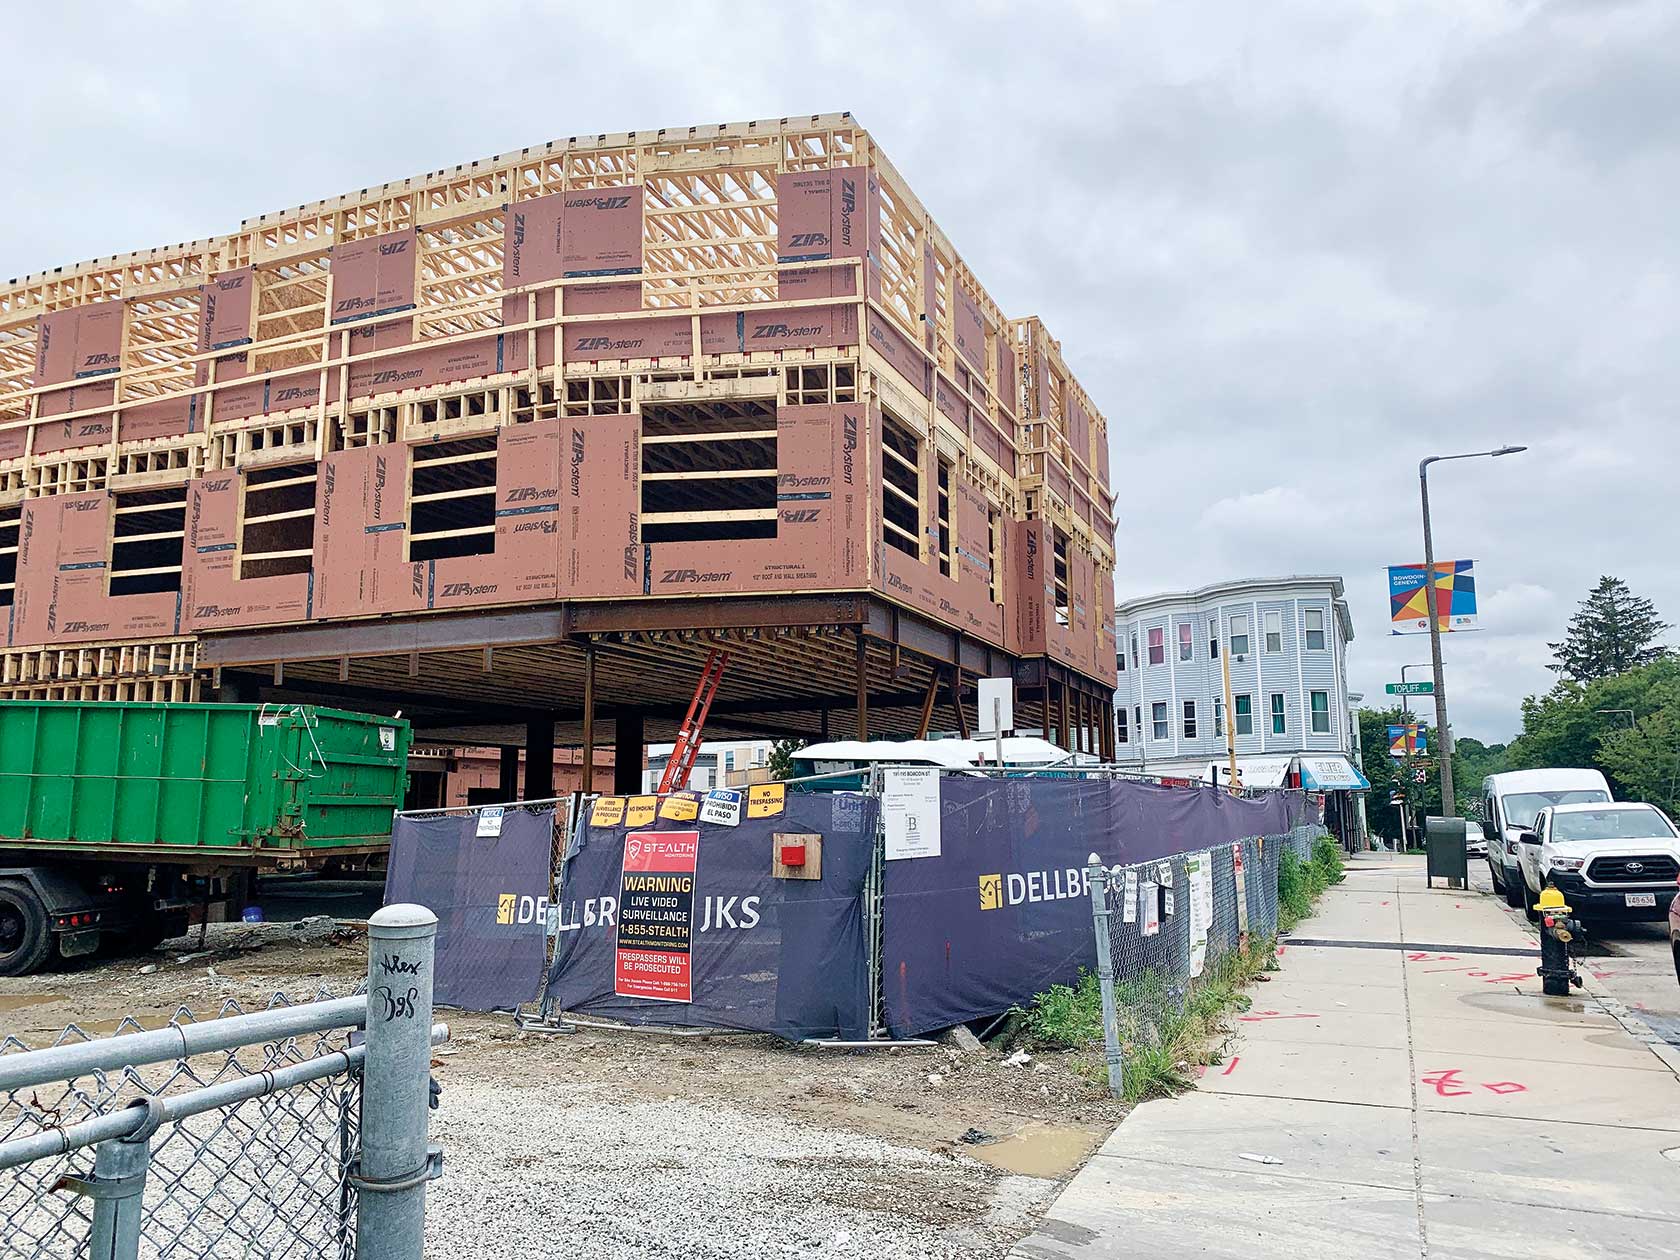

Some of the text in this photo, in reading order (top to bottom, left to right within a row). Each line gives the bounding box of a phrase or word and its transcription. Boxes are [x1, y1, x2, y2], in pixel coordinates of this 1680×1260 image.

[1393, 684, 1420, 693] TOPLIFF
[714, 791, 733, 800] AVISO
[750, 797, 783, 805] TRESPASSING
[705, 800, 738, 812] PROHIBIDO
[714, 809, 732, 820] PASO
[643, 843, 695, 853] STEALTH
[624, 876, 691, 893] WARNING
[631, 896, 678, 908] LIVE VIDEO
[622, 909, 688, 922] SURVEILLANCE
[620, 924, 689, 938] 1-855-STEALTH
[618, 952, 687, 966] TRESPASSERS WILL
[623, 962, 681, 975] BE PROSECUTED
